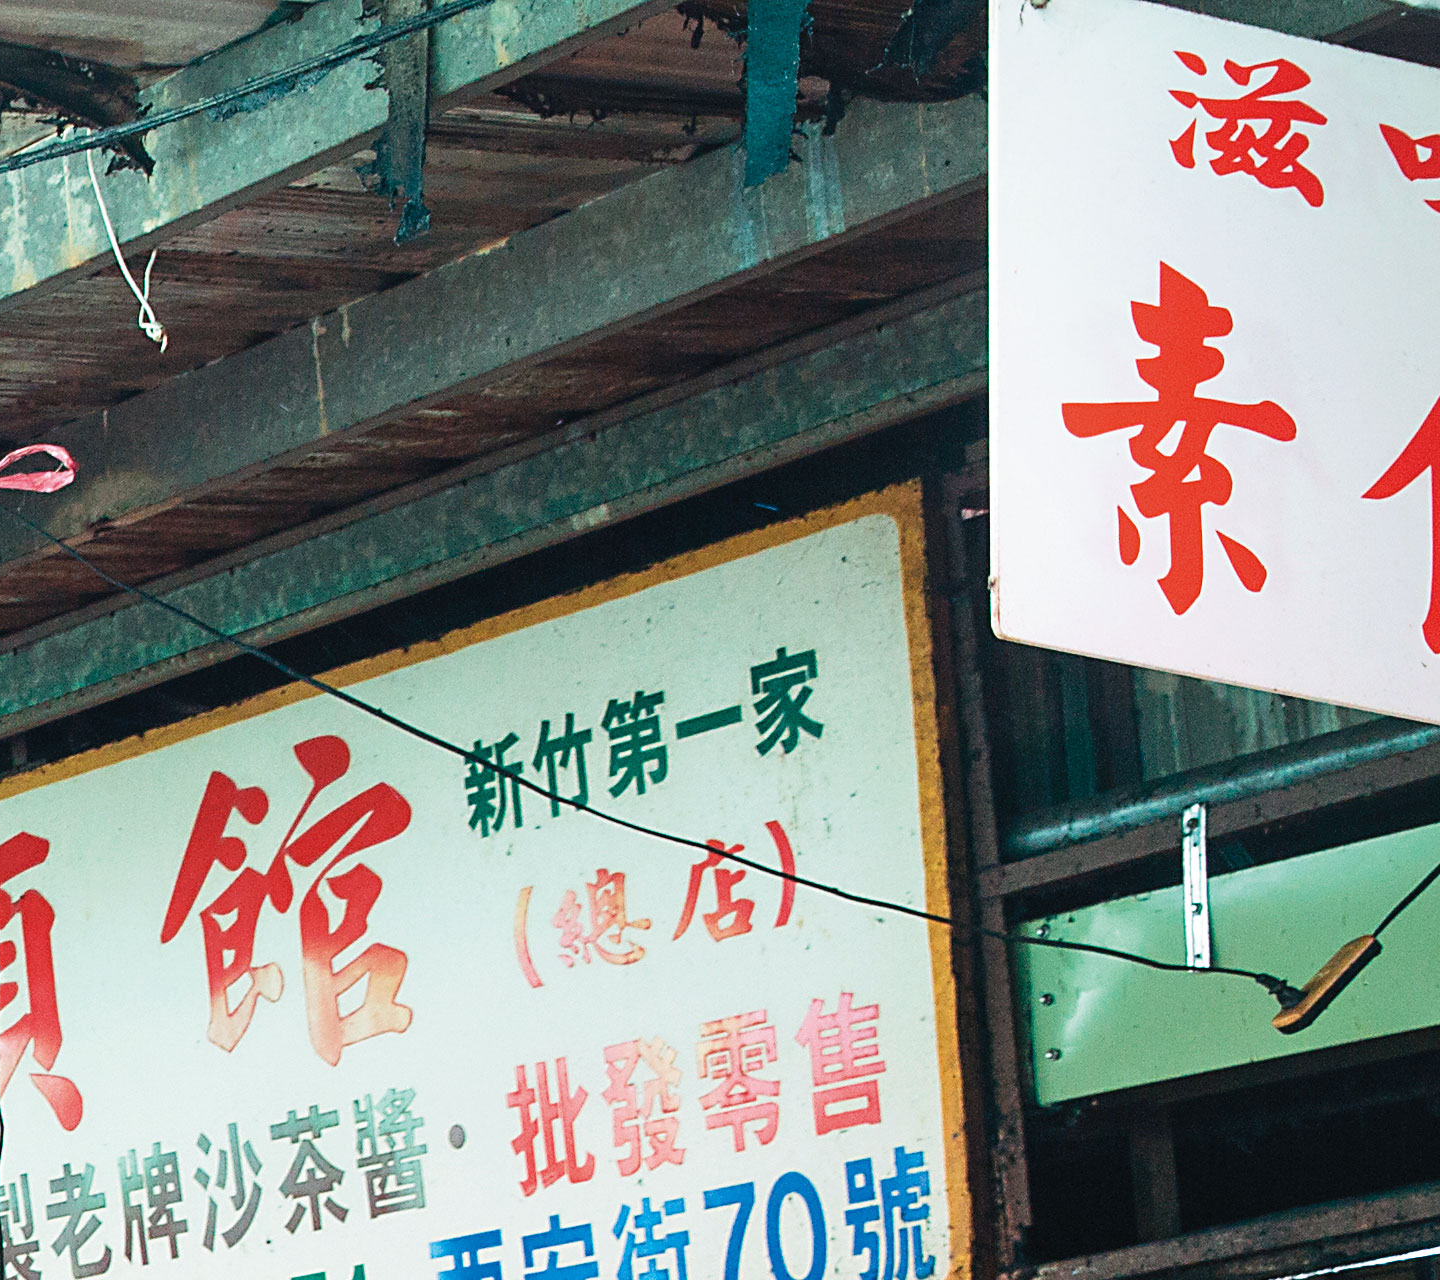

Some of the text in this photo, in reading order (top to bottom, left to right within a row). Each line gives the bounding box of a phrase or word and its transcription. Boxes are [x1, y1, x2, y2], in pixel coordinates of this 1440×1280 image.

[463, 647, 824, 837] 新竹第一家
[507, 990, 886, 1199] 批發零售
